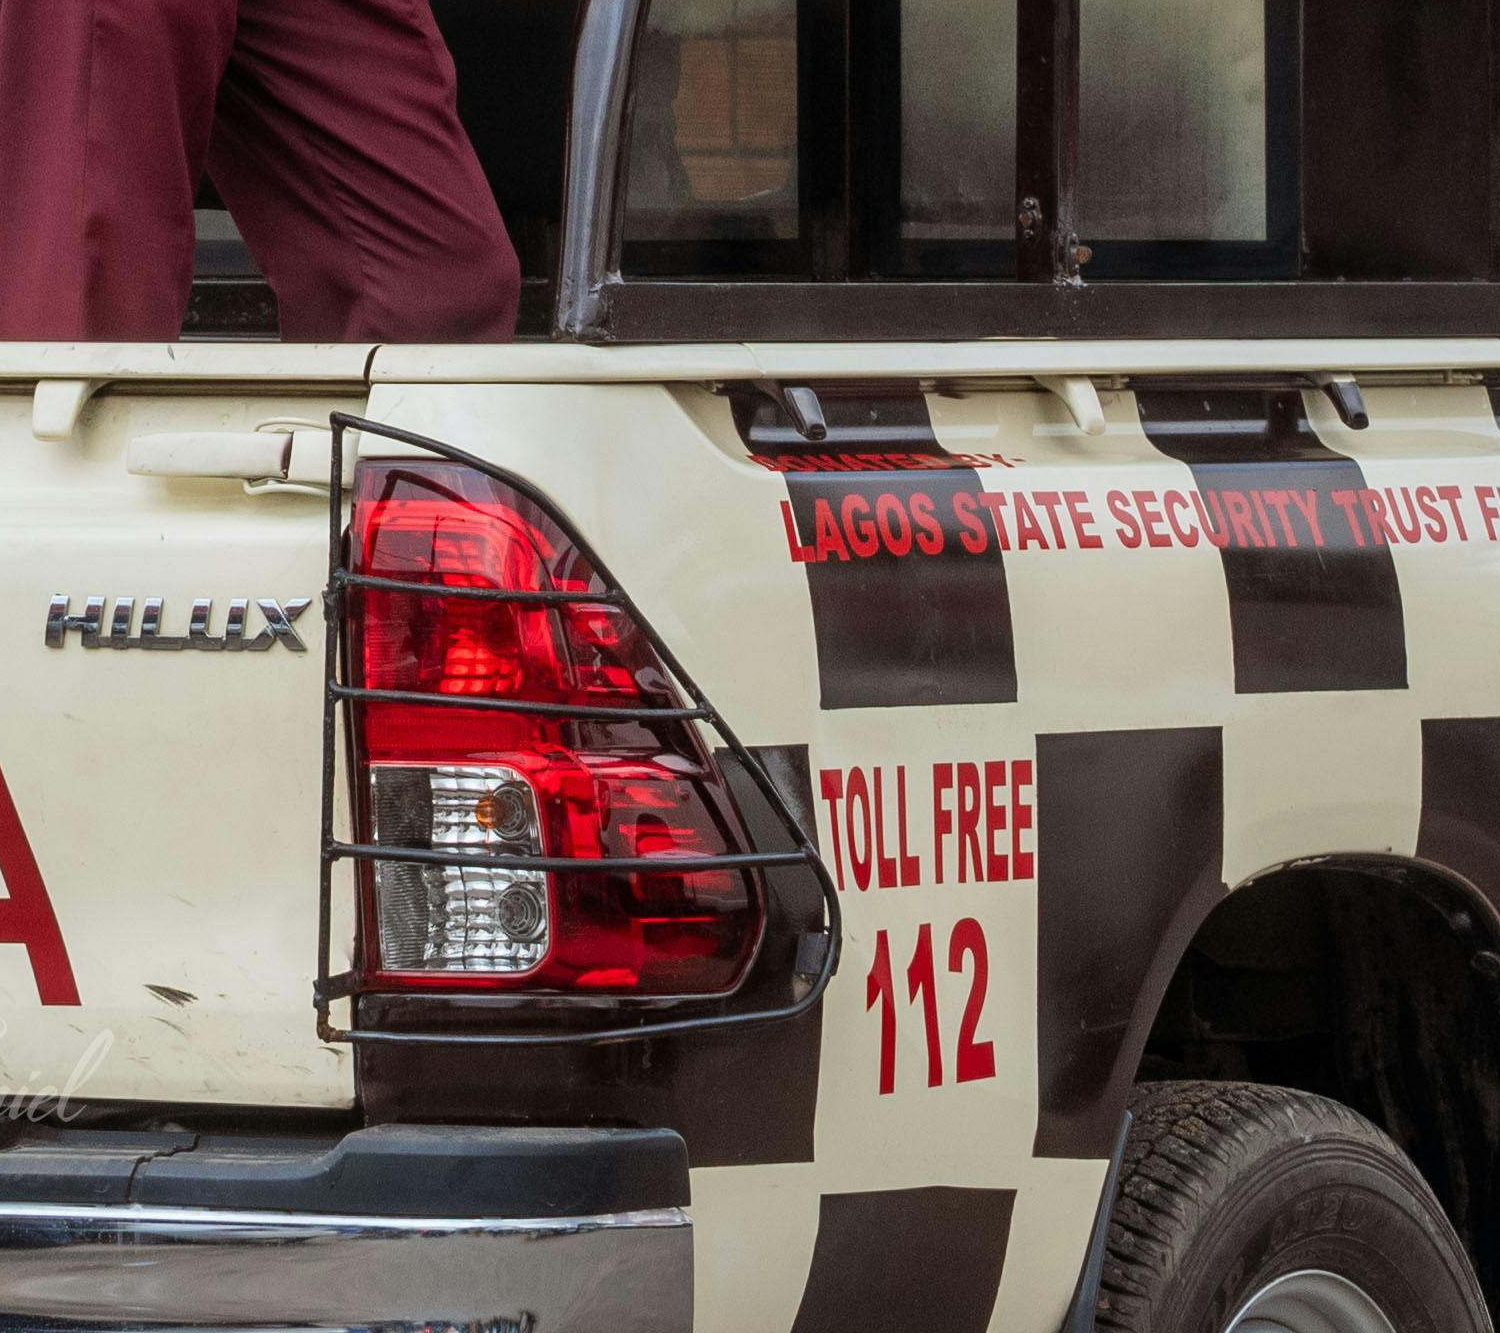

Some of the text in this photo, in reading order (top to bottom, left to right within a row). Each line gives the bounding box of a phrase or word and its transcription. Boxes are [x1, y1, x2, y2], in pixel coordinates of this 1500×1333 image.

[747, 453, 944, 472] DONATED
[779, 492, 945, 564] LAGOS
[951, 490, 1104, 555] STATE
[1106, 487, 1325, 550] SECURITY
[1331, 485, 1469, 548] TRUST
[45, 595, 312, 651] HILUX
[819, 759, 1035, 892] TOLL FREE
[866, 916, 997, 1096] 112
